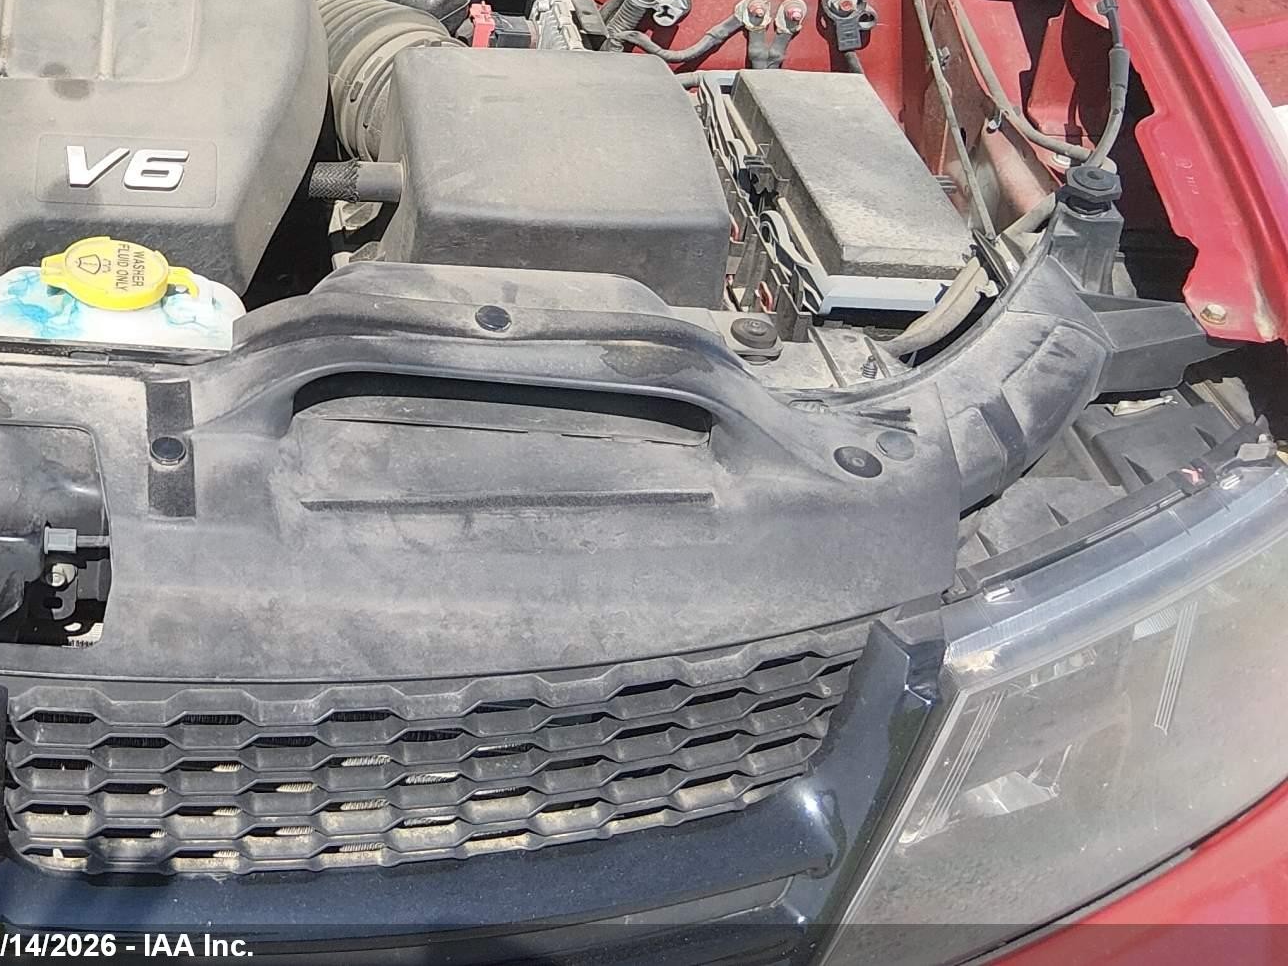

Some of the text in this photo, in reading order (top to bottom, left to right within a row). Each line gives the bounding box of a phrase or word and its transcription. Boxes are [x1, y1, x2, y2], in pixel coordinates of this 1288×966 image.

[66, 145, 190, 192] V6
[115, 243, 130, 291] FLUID ONLY
[131, 251, 145, 287] WASHER
